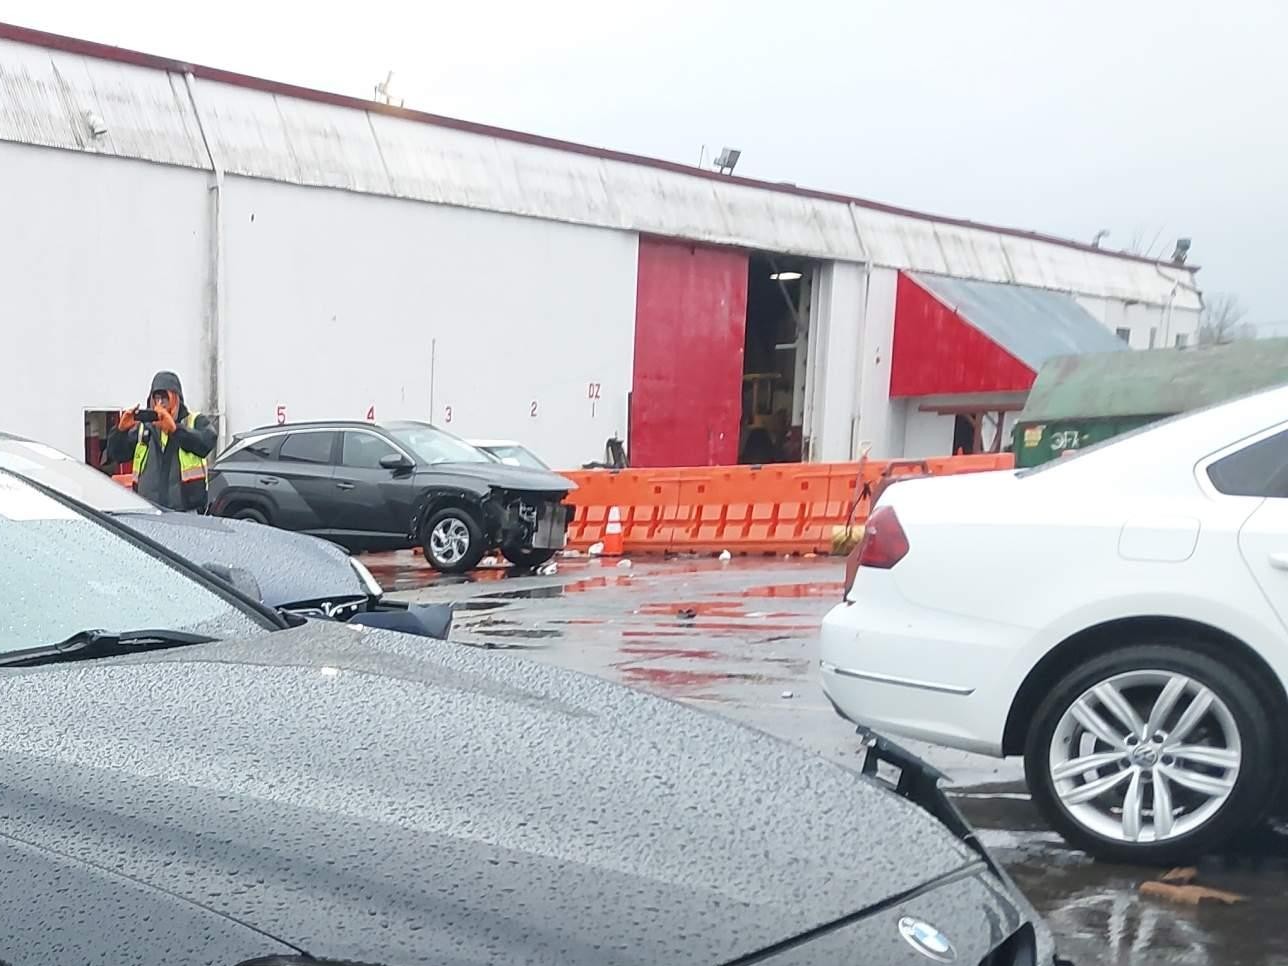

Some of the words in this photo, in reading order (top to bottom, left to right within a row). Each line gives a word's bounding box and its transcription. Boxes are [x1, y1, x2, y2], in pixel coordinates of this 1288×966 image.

[276, 406, 287, 424] 5
[366, 406, 376, 422] 4
[445, 406, 453, 423] 3
[530, 401, 538, 417] 2
